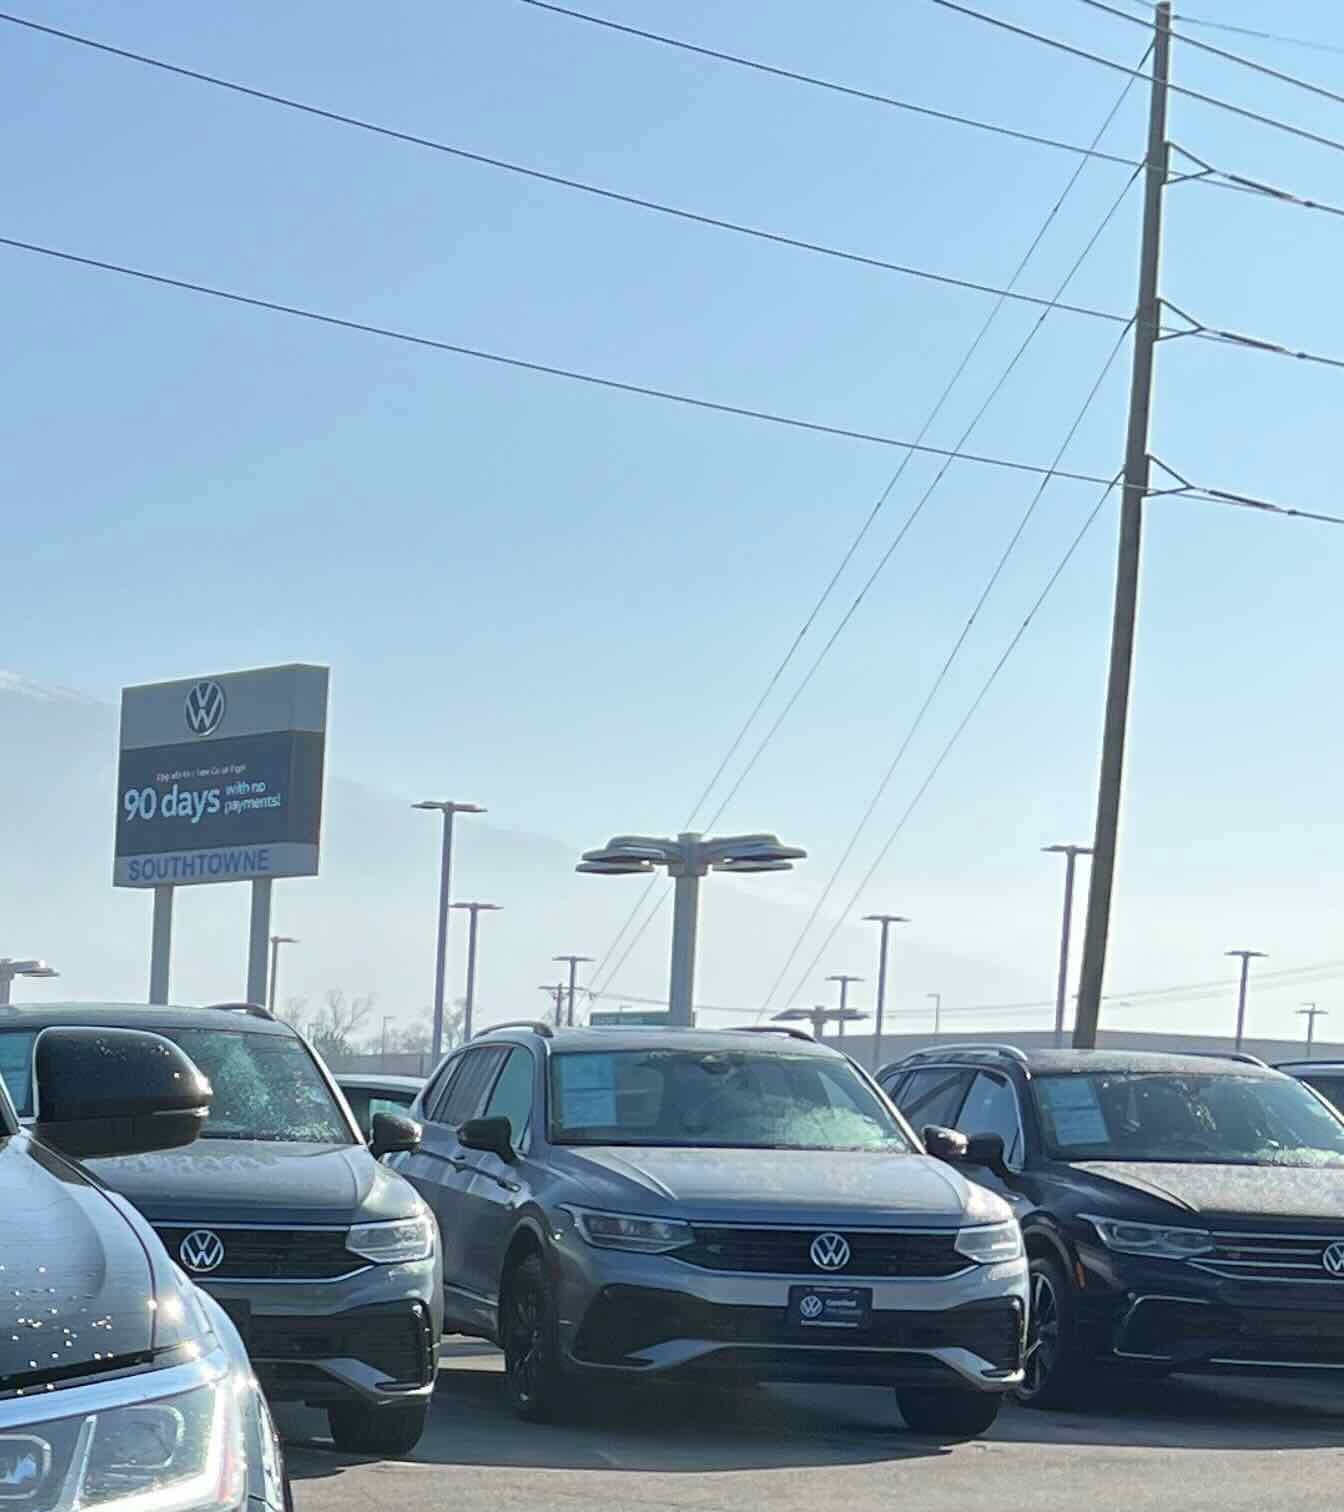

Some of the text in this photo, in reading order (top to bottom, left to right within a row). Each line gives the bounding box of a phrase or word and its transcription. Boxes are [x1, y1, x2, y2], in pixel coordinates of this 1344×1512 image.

[185, 680, 225, 736] VW
[124, 784, 220, 823] 90 days
[226, 781, 266, 796] with no
[128, 850, 270, 881] SOUTHTOWNE
[180, 1230, 224, 1272] VW
[810, 1232, 850, 1271] VW
[800, 1296, 823, 1318] VW
